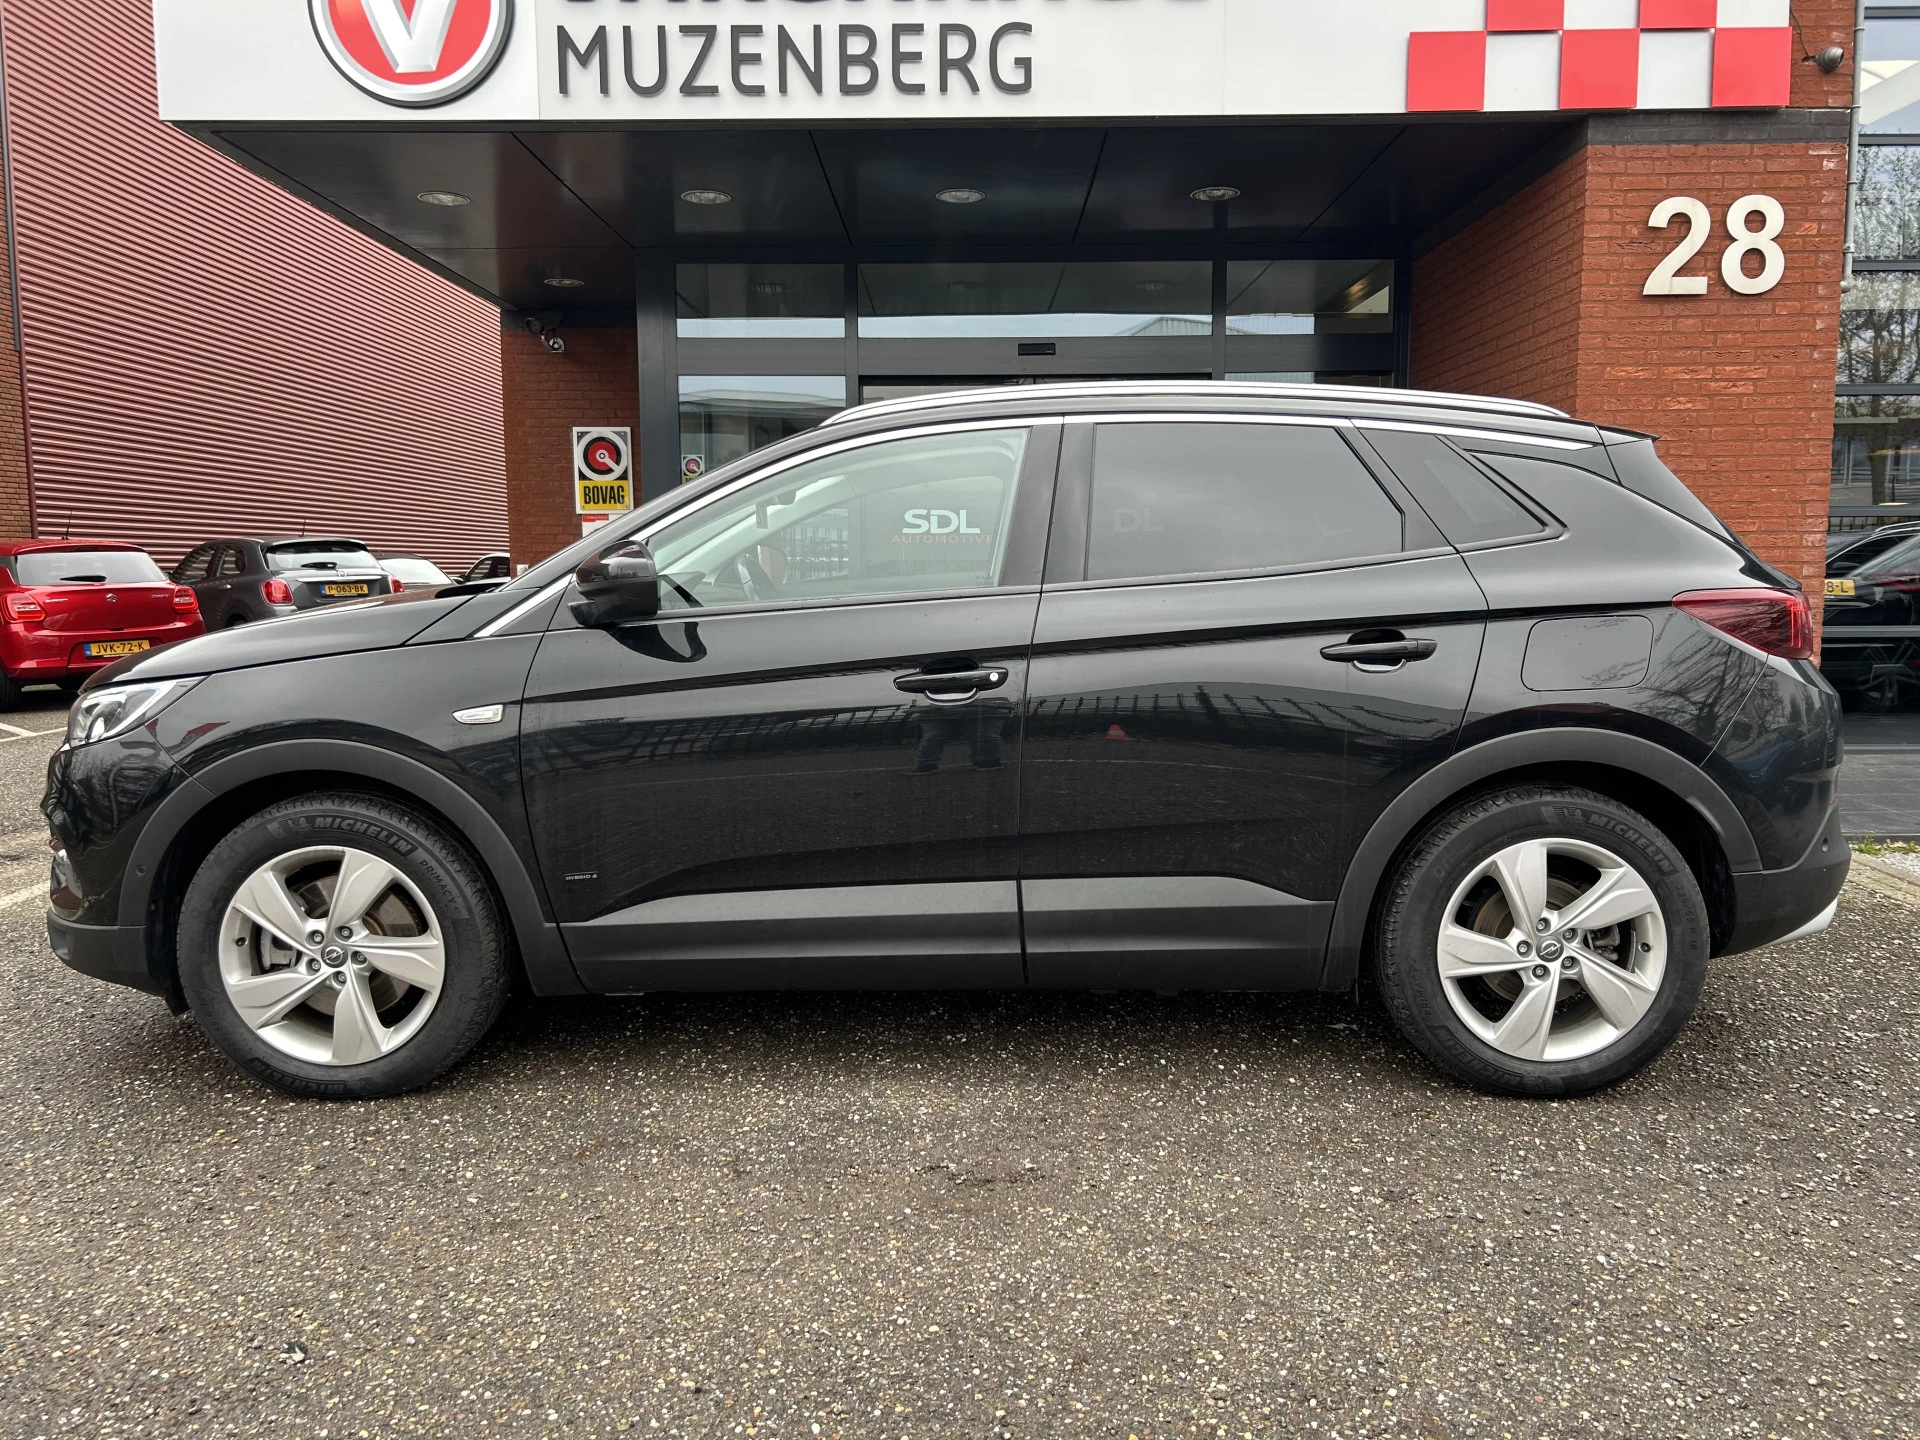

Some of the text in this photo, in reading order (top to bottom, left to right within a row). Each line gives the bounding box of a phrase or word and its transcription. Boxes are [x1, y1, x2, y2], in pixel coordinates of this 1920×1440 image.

[556, 21, 1033, 96] MUZENBERG
[1643, 194, 1785, 295] 28
[583, 485, 625, 505] BOVAG
[901, 508, 981, 534] SDL
[1108, 508, 1164, 533] DL
[891, 534, 993, 544] AUTOMOTIVE
[327, 584, 366, 593] P-063-BK
[1826, 580, 1849, 593] 8-L
[96, 641, 145, 654] JVK-72-K
[314, 816, 413, 854] MICHELIN
[1588, 813, 1674, 876] MICHELIN
[419, 859, 458, 904] PRIMACY
